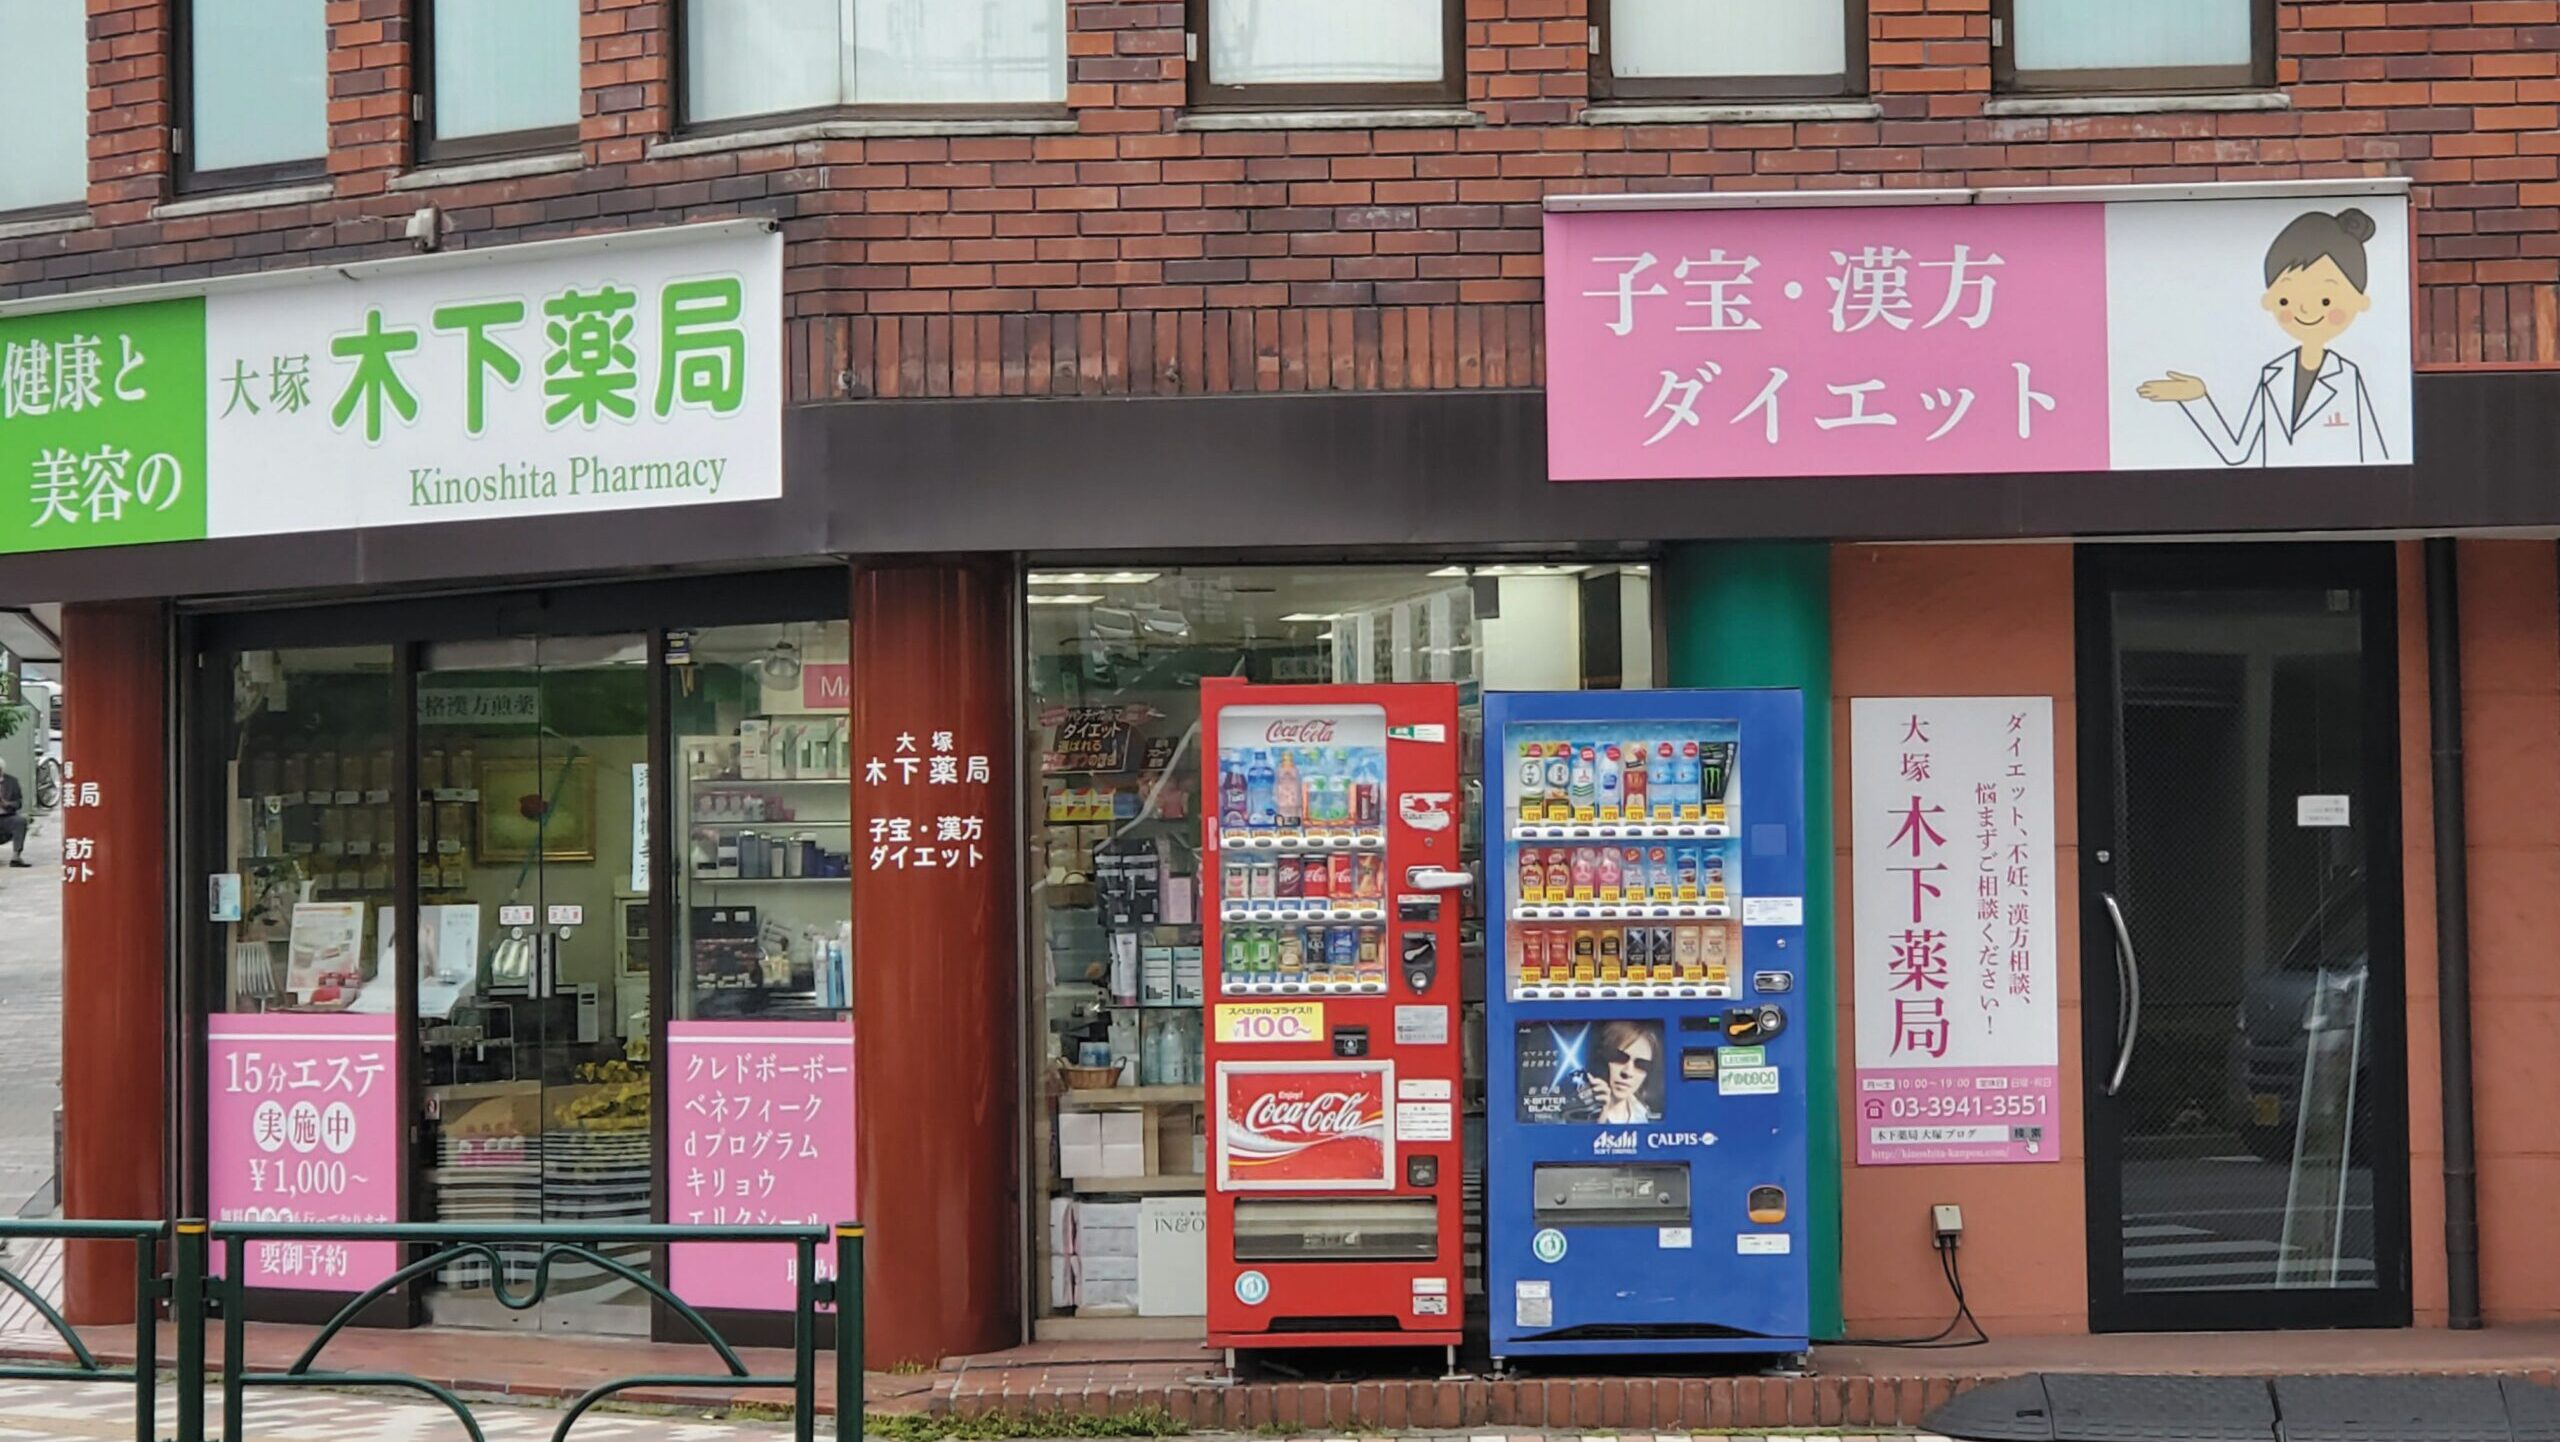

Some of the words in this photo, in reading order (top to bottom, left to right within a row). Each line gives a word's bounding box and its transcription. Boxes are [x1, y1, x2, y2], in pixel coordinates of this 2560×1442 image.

[1582, 244, 2006, 336] 子宝・漢方
[0, 333, 147, 420] 健康と
[219, 353, 311, 419] 大塚
[329, 276, 746, 443] 木下薬局
[1641, 359, 2057, 446] ダイエット
[29, 446, 183, 530] 美容の
[409, 462, 558, 507] Kinoshita
[567, 455, 728, 498] Pharmacy
[896, 731, 954, 753] 大塚
[1900, 714, 1930, 782] 大塚
[865, 755, 990, 786] 木下薬局
[869, 815, 984, 843] 子宝・漢方
[869, 843, 984, 871] ダイエット
[1886, 795, 1950, 1059] 木下薬局
[225, 1052, 385, 1098] 15分エステ
[257, 1106, 352, 1149] 実施中
[1890, 1095, 2048, 1118] 03-3941-3551
[1593, 1130, 1638, 1149] Asahi
[1647, 1132, 1698, 1149] CALPIS
[686, 1166, 776, 1198] キリョウ
[259, 1242, 347, 1277] 要御予約
